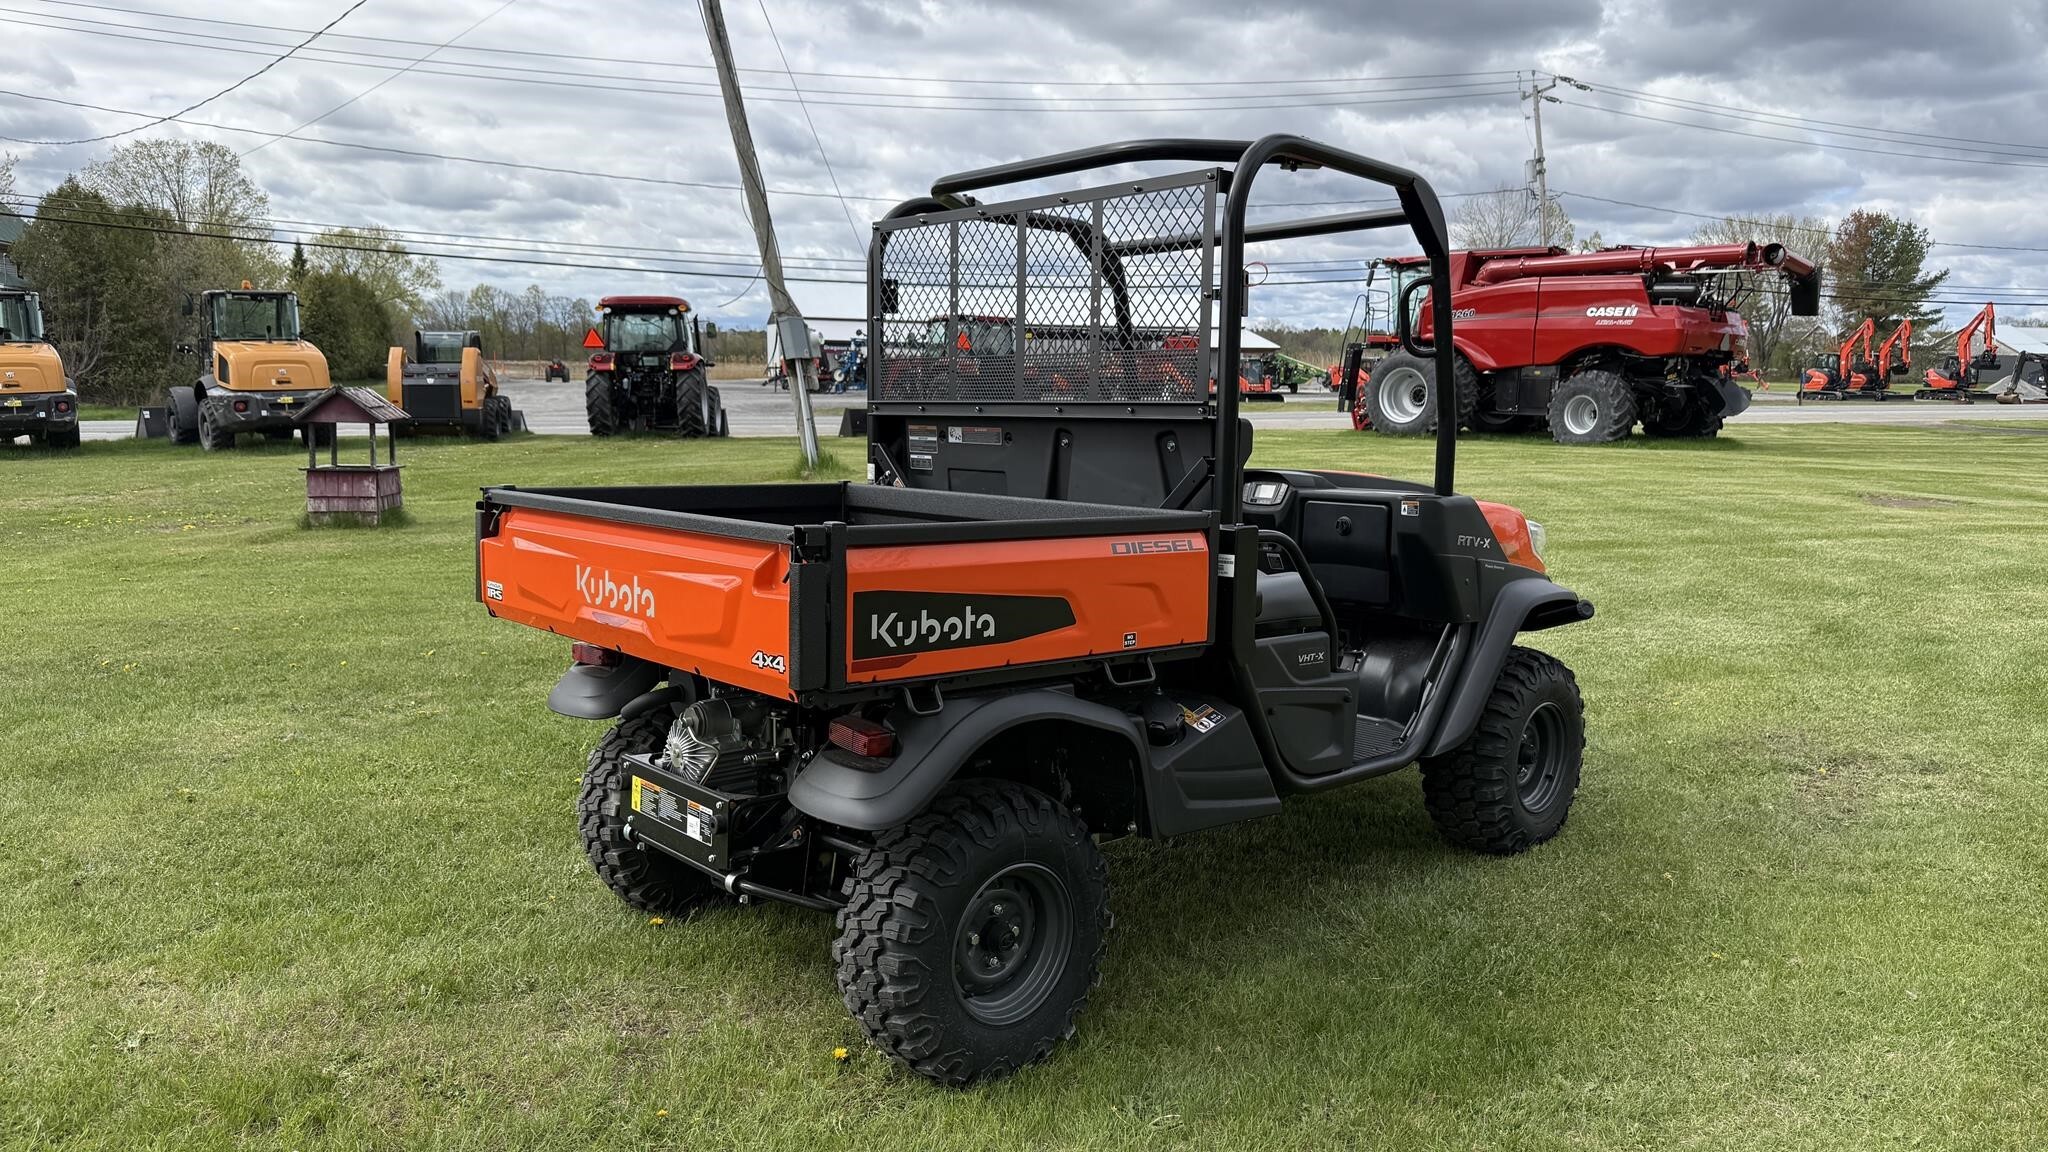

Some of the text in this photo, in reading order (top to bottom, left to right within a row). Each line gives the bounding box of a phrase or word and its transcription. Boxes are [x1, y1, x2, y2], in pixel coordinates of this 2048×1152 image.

[1586, 306, 1625, 318] CASE
[1110, 539, 1205, 555] DIESEL
[1457, 534, 1491, 549] RTV-X
[487, 587, 503, 601] IRS
[576, 564, 655, 618] Kubota
[871, 605, 995, 648] Kubota
[751, 650, 786, 674] 4x4
[1298, 651, 1325, 663] VHT-X
